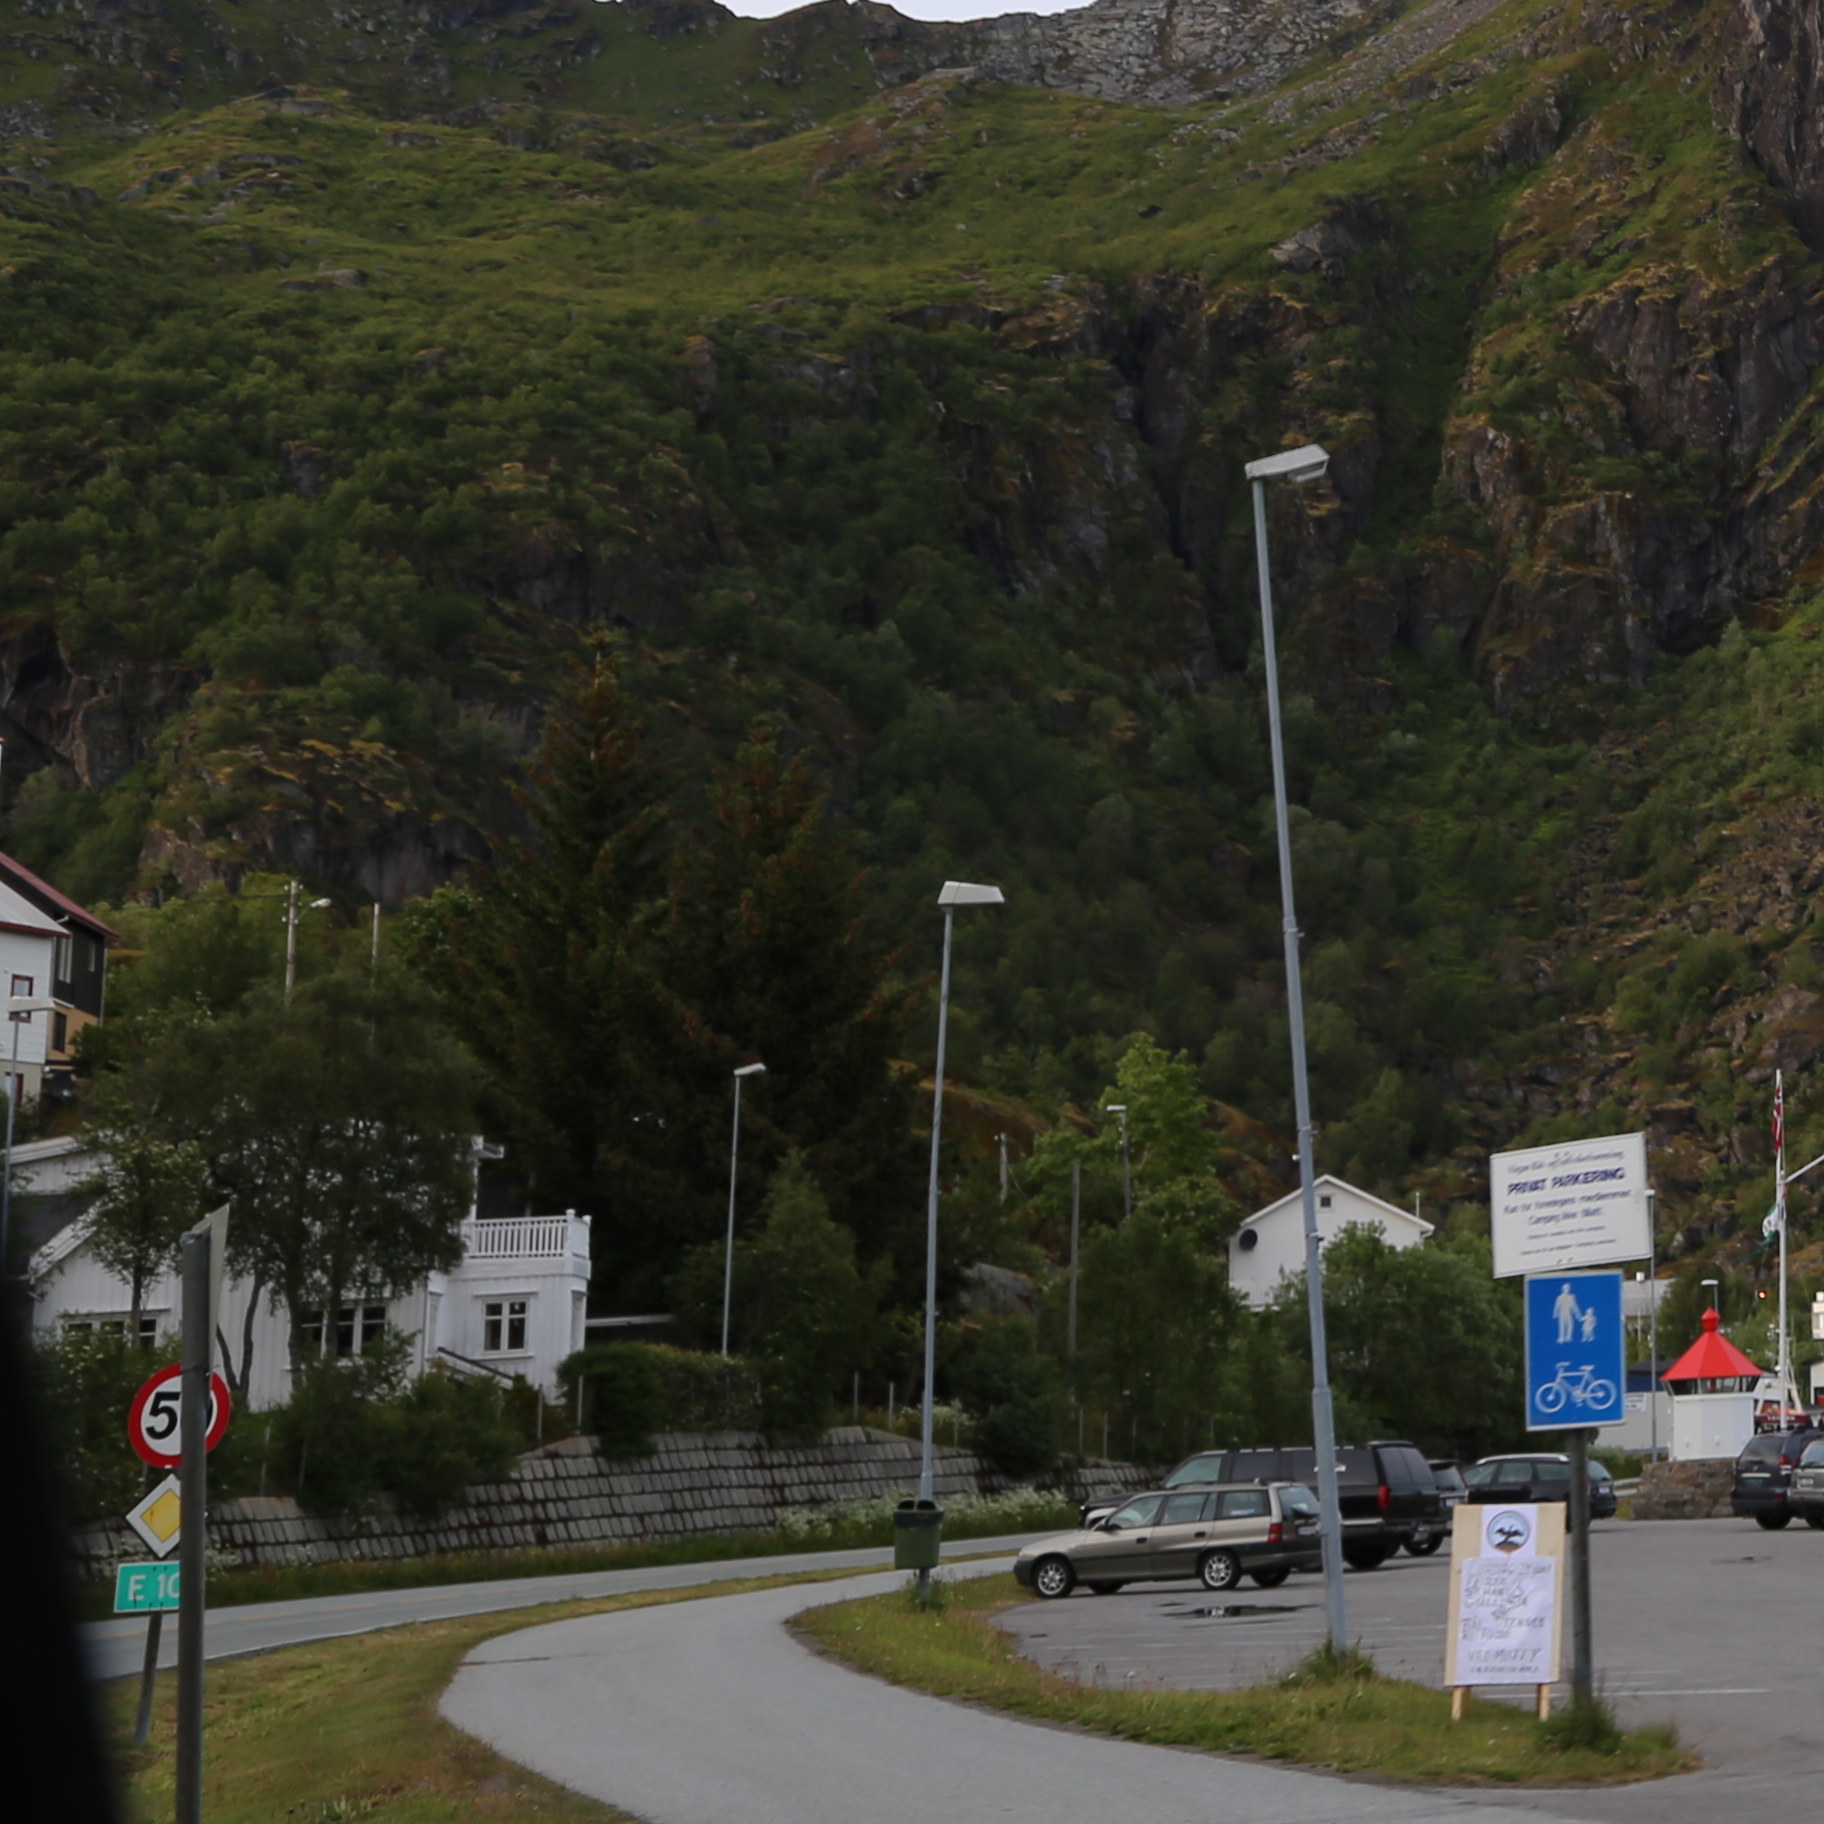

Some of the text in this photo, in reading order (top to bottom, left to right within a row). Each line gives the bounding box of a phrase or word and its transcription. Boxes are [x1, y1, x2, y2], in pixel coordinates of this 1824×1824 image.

[1507, 1167, 1625, 1195] PRIVAT PARKERING
[128, 1575, 146, 1601] E
